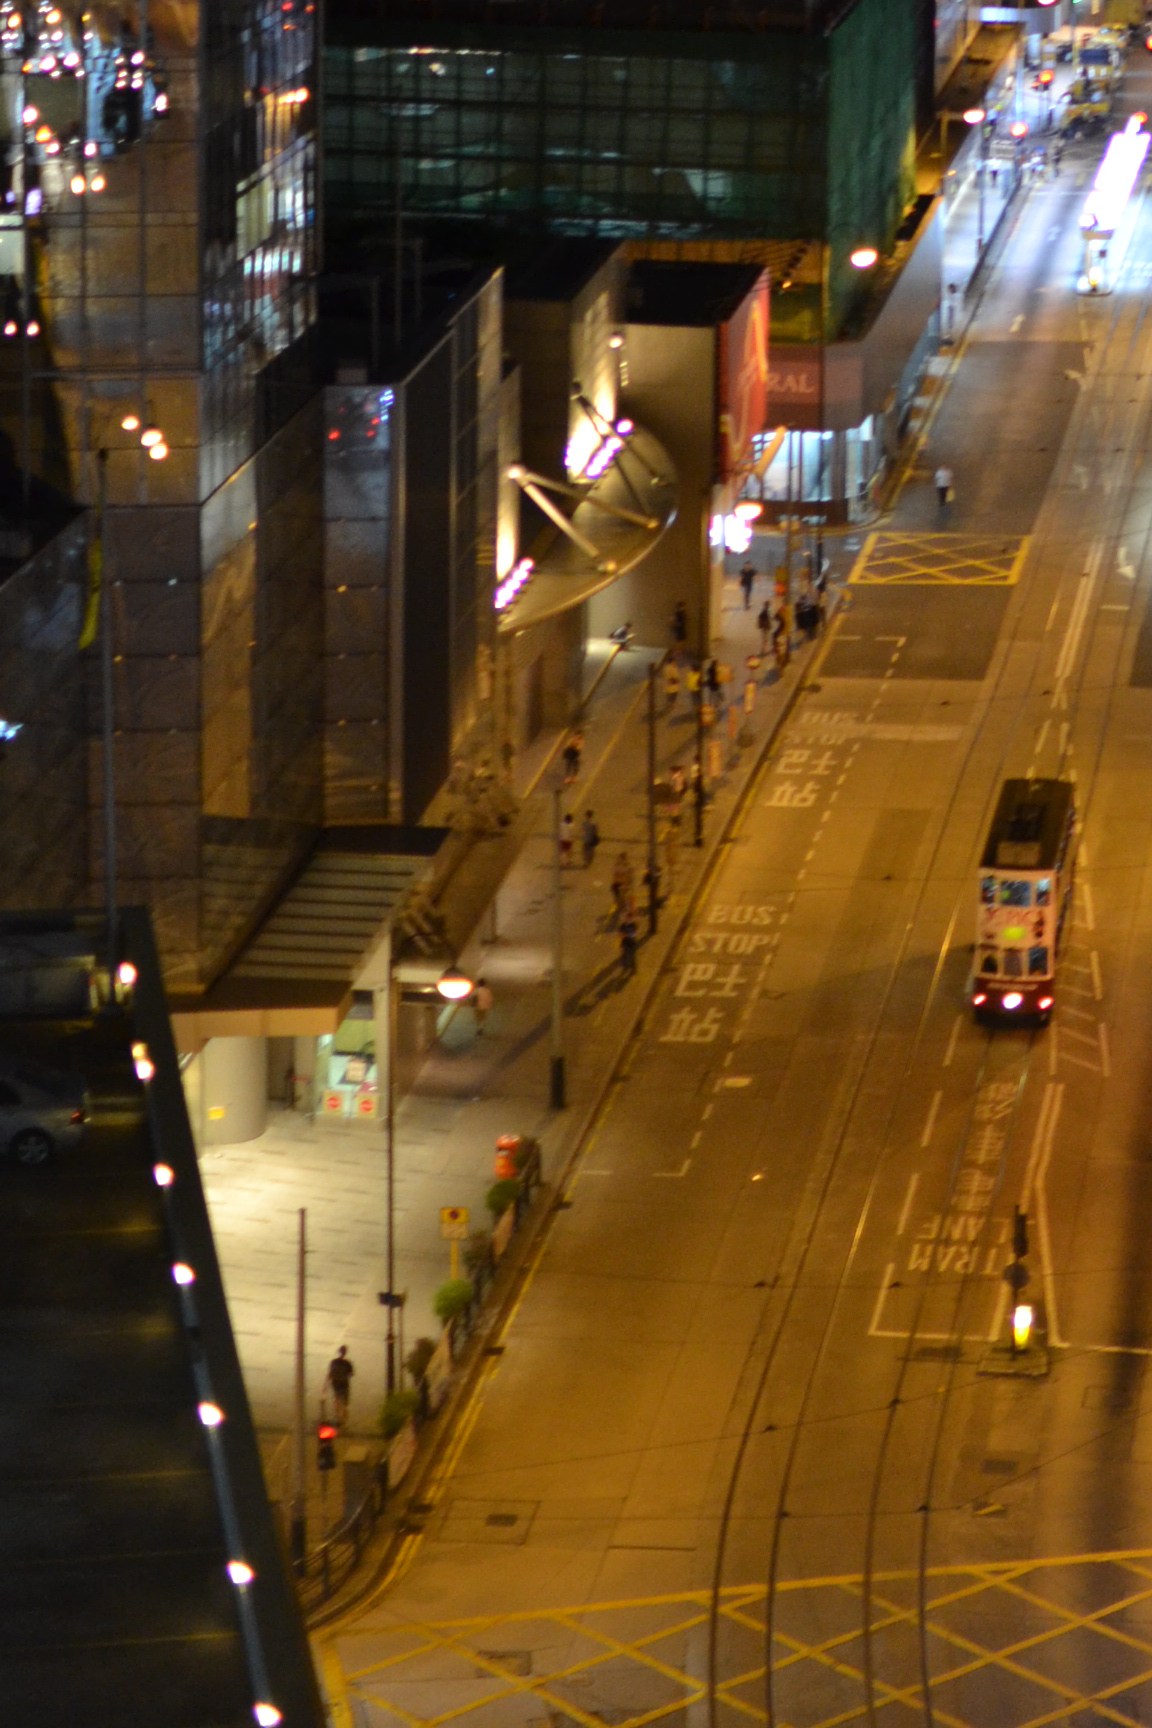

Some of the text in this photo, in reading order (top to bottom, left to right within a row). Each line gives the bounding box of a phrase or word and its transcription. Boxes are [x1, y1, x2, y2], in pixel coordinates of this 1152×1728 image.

[776, 749, 838, 776] 巴士
[765, 781, 820, 808] 站
[707, 904, 777, 925] BUS
[688, 932, 773, 954] STOP
[674, 962, 747, 998] 巴士
[659, 1006, 725, 1043] 站
[914, 1214, 1011, 1245] LANE
[906, 1242, 999, 1276] TRAM
